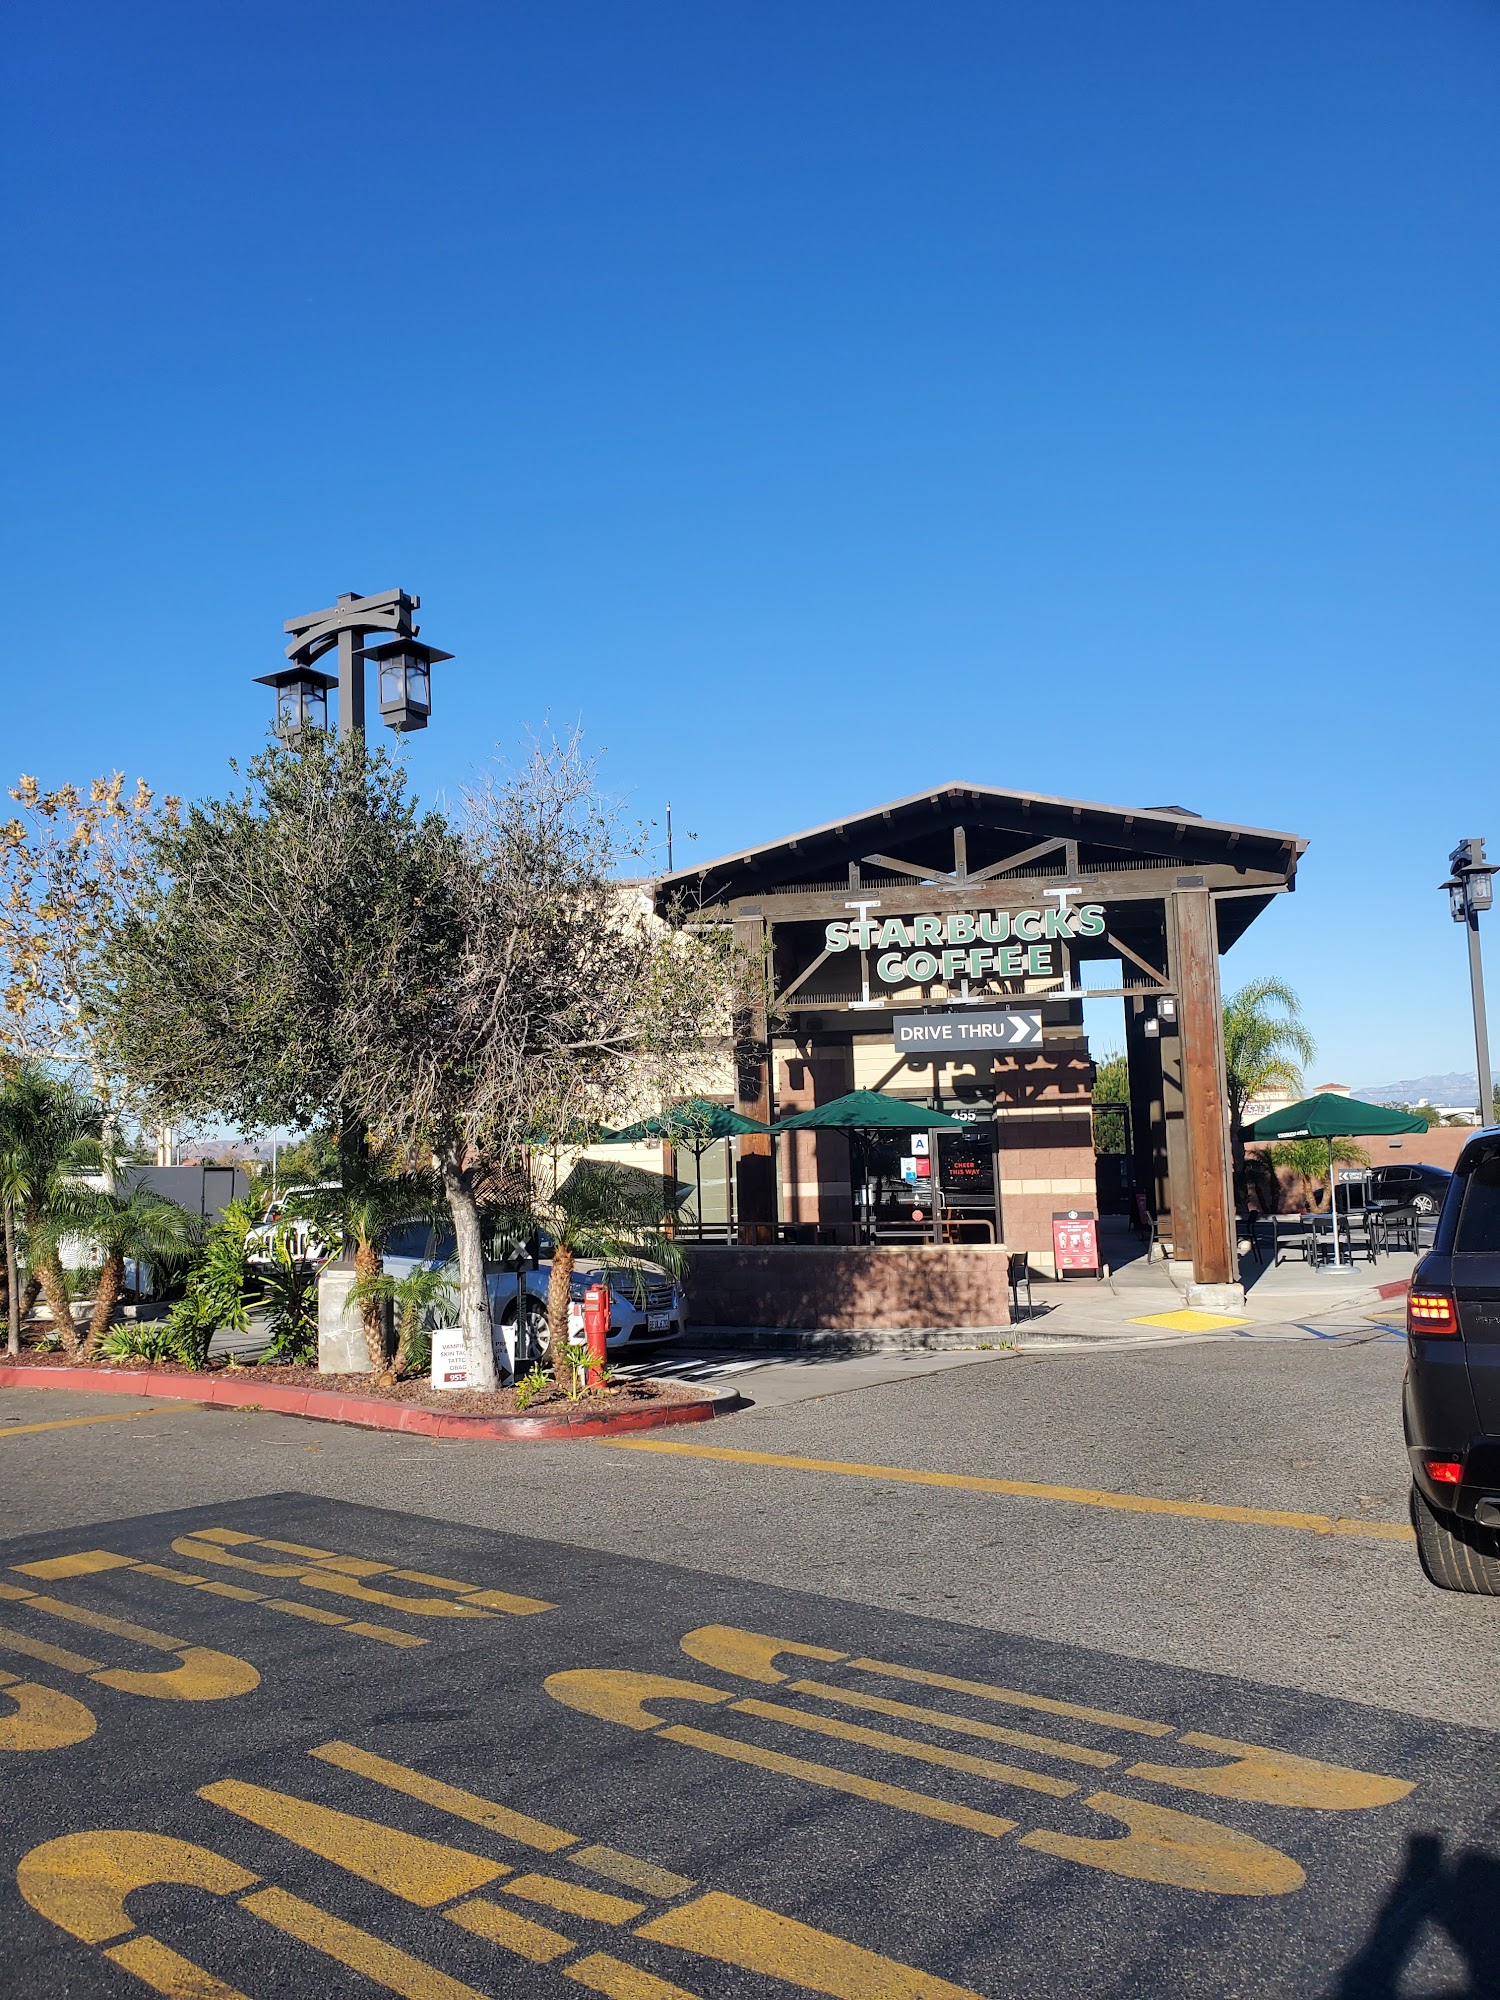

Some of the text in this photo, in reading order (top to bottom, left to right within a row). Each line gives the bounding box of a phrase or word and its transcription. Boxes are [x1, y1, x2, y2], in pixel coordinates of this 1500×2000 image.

[824, 904, 1106, 952] STARBUCKS
[876, 944, 1053, 983] COFFEE
[900, 1023, 1005, 1041] DRIVE THRU
[950, 1109, 977, 1121] 455
[915, 1139, 925, 1149] A
